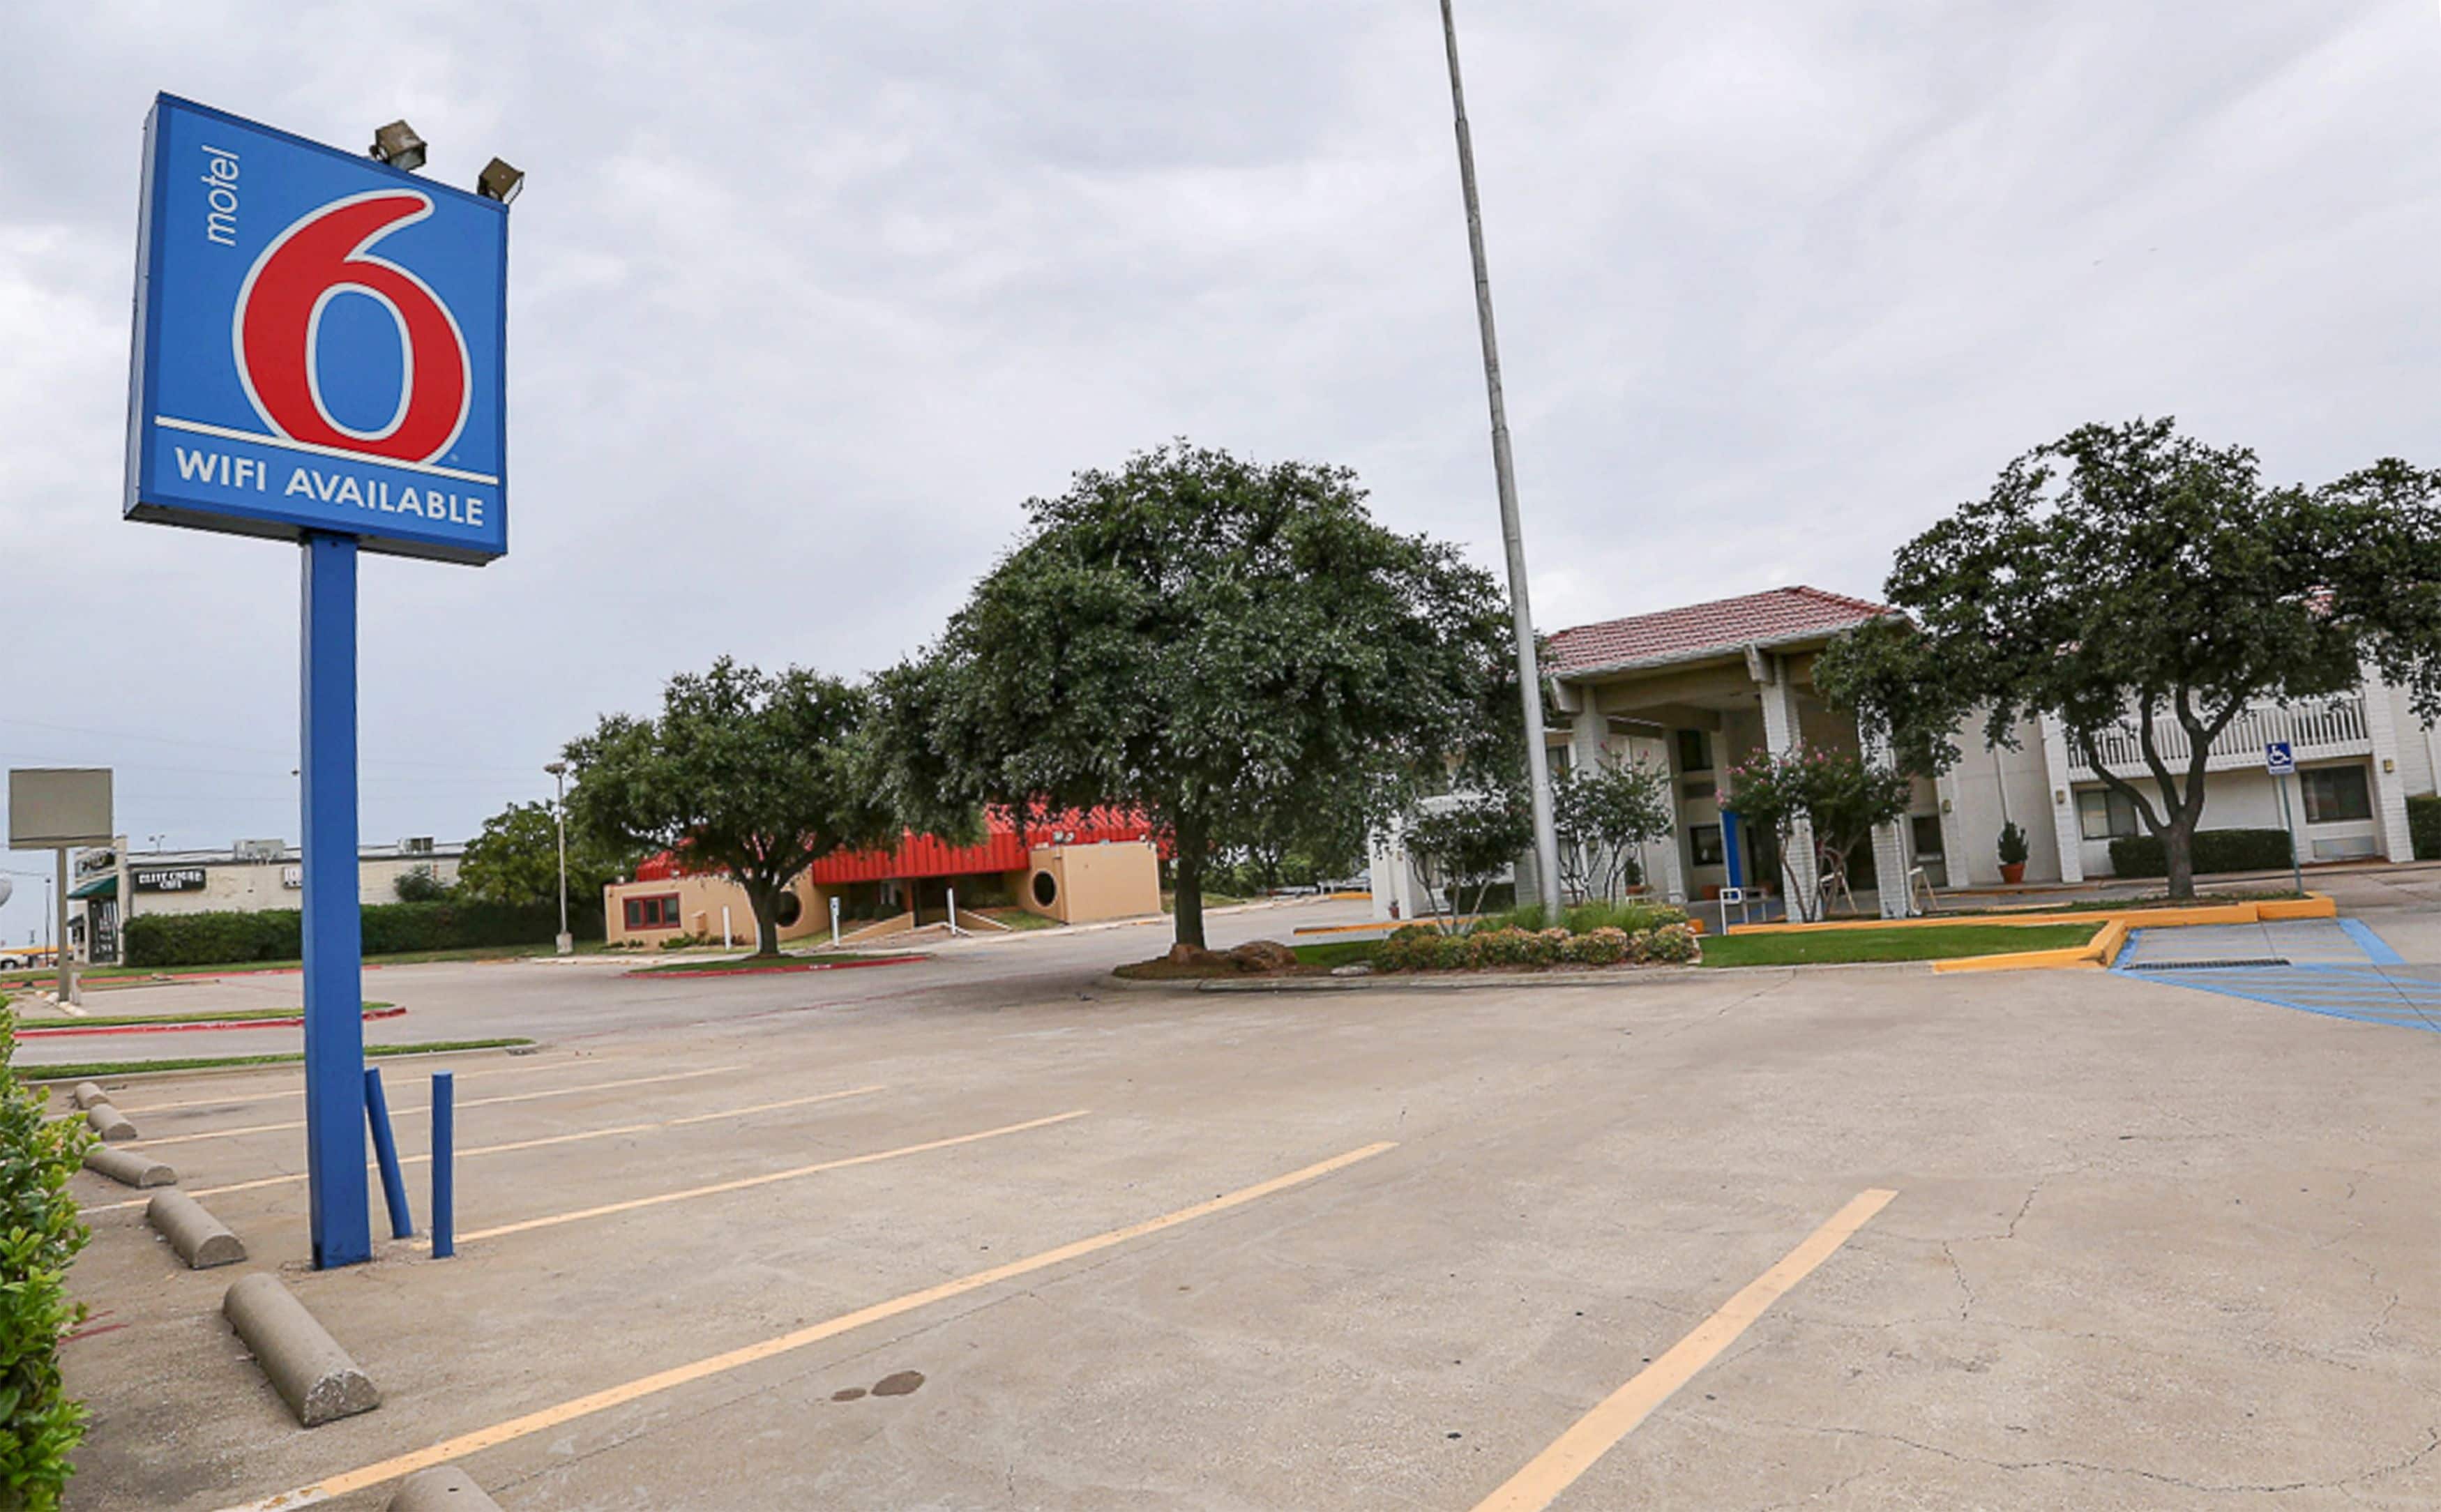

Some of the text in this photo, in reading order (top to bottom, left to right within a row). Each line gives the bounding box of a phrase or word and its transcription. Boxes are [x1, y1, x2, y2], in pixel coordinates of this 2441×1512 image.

[202, 144, 239, 246] motel
[233, 189, 471, 465] 6
[175, 446, 483, 527] WIFI AVAILABLE
